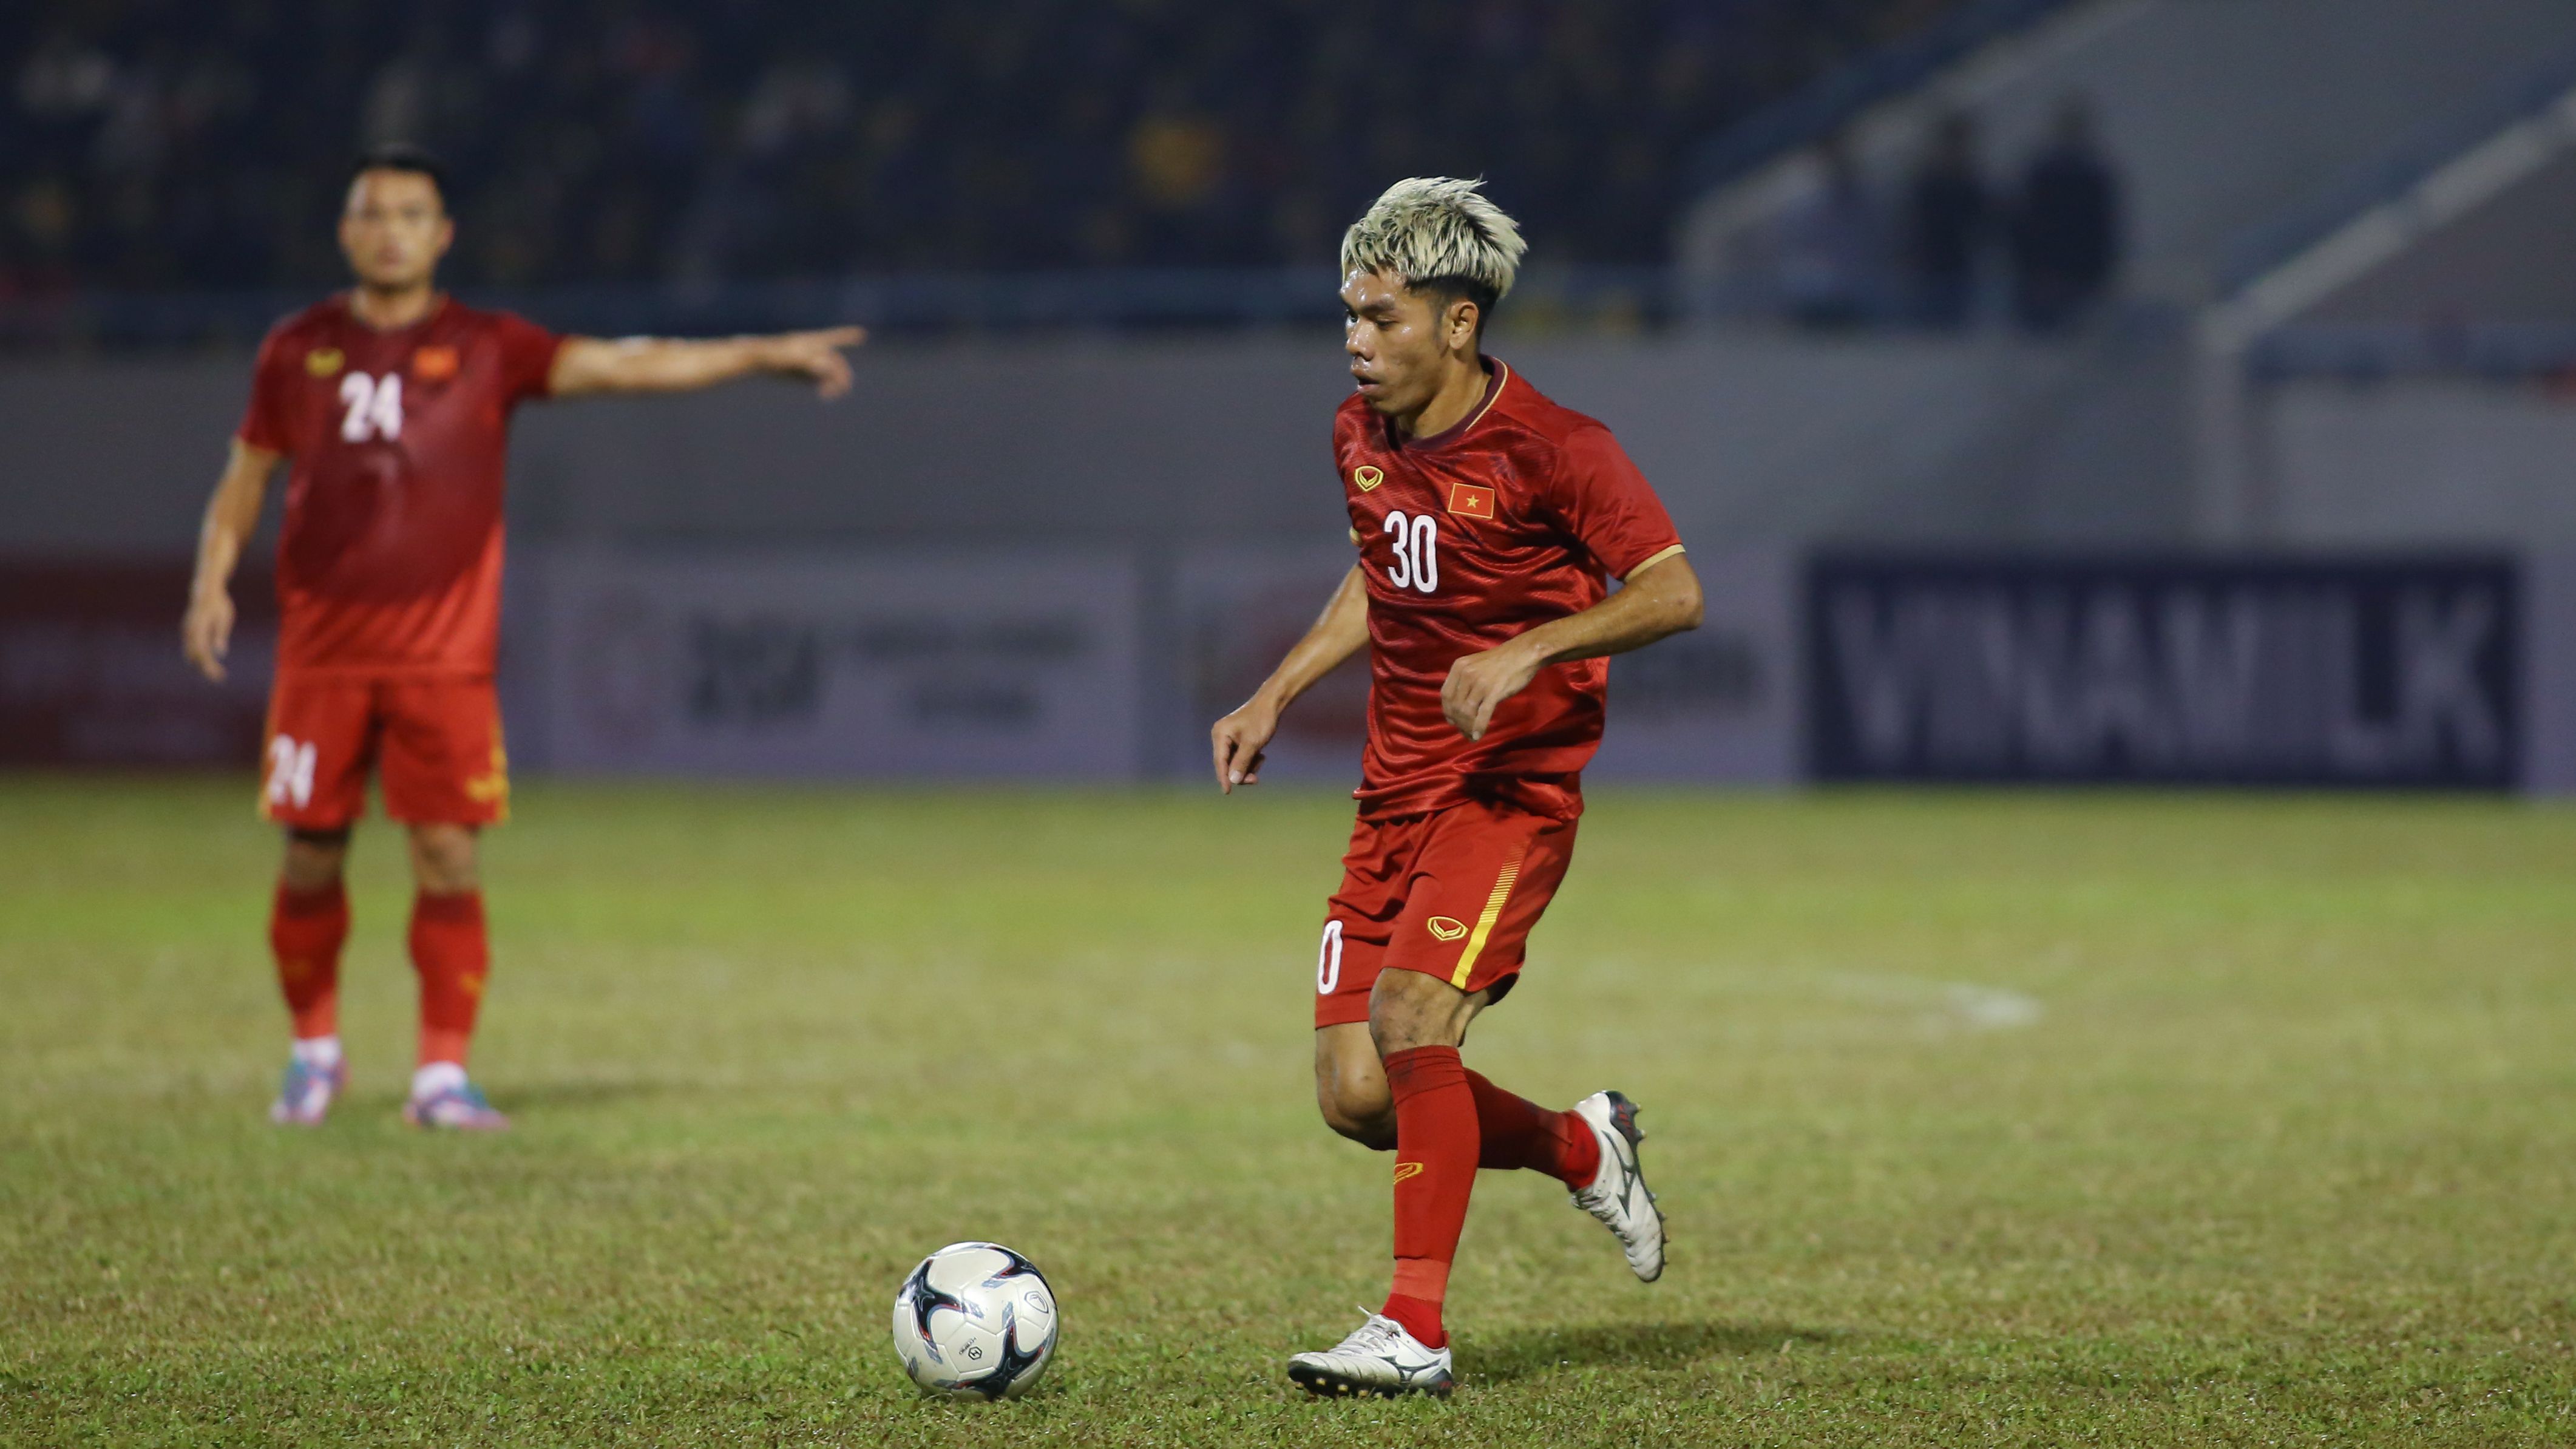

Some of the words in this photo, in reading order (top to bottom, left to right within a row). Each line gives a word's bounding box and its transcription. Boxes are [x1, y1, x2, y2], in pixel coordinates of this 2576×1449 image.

[340, 372, 402, 443] 24
[1384, 510, 1438, 593] 30
[268, 734, 317, 809] 24
